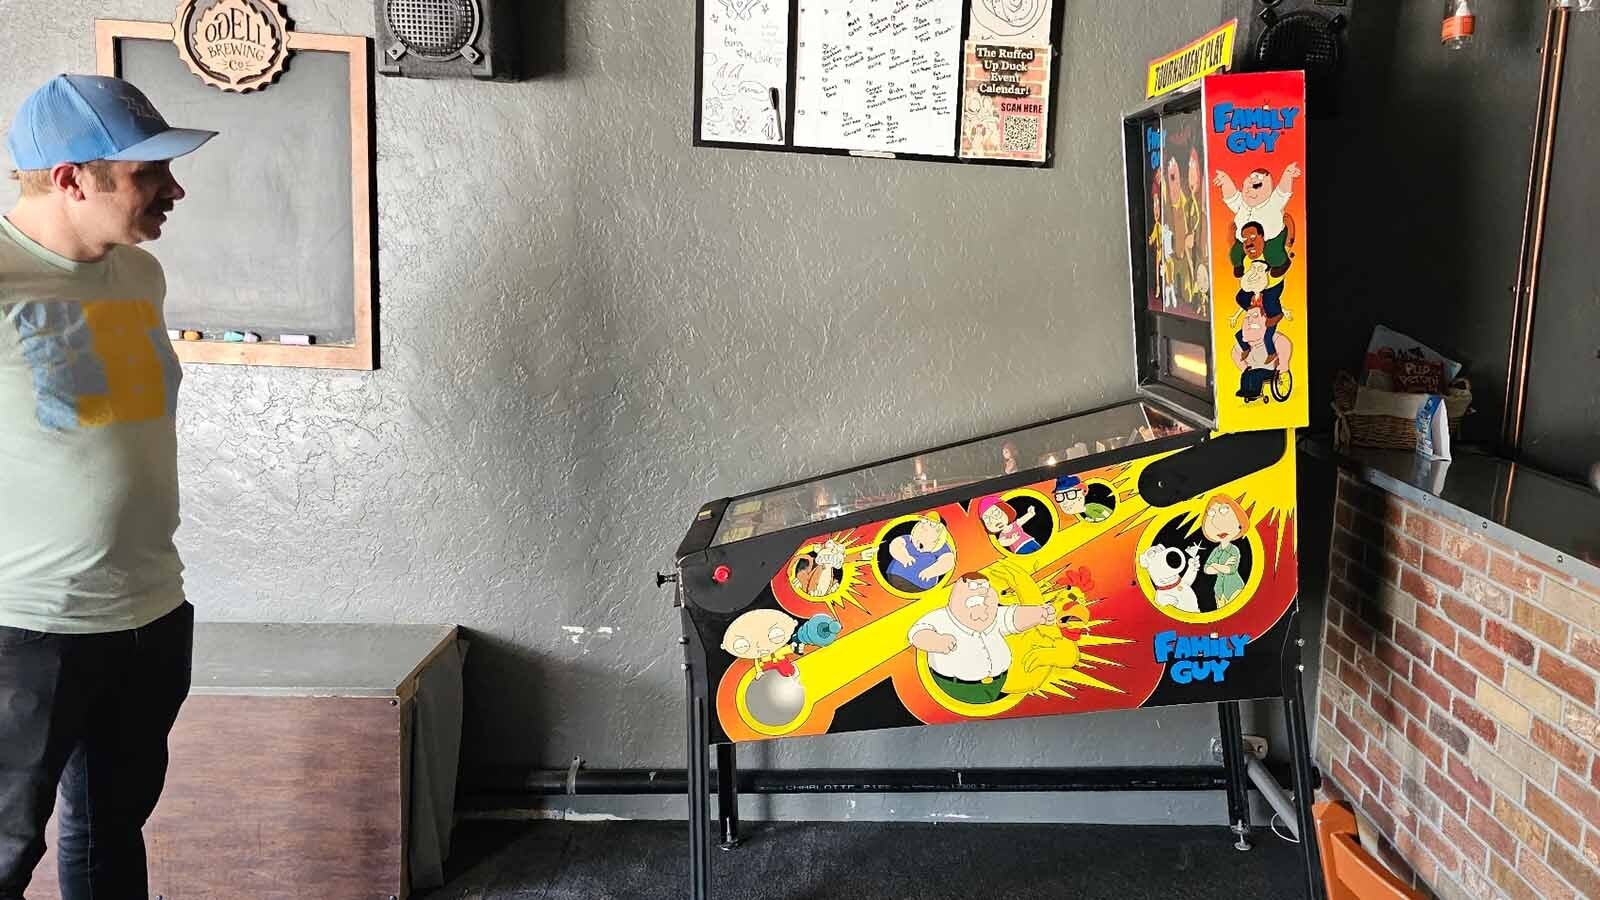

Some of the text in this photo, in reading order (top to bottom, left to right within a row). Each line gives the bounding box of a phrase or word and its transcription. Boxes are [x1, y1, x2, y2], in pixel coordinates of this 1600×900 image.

[205, 7, 266, 48] ODELL
[207, 42, 265, 61] BREWING
[976, 47, 1034, 60] The Ruffed
[1154, 32, 1226, 92] TOURNAMENT PLAY
[984, 60, 1028, 72] Up Duck
[990, 72, 1020, 83] Event
[979, 83, 1031, 96] Calendar!
[1000, 102, 1043, 114] SCAN HERE
[1213, 101, 1300, 133] FAMILY
[1226, 130, 1280, 153] GUY
[1153, 630, 1252, 664] FAMILY
[1170, 659, 1231, 685] GUY
